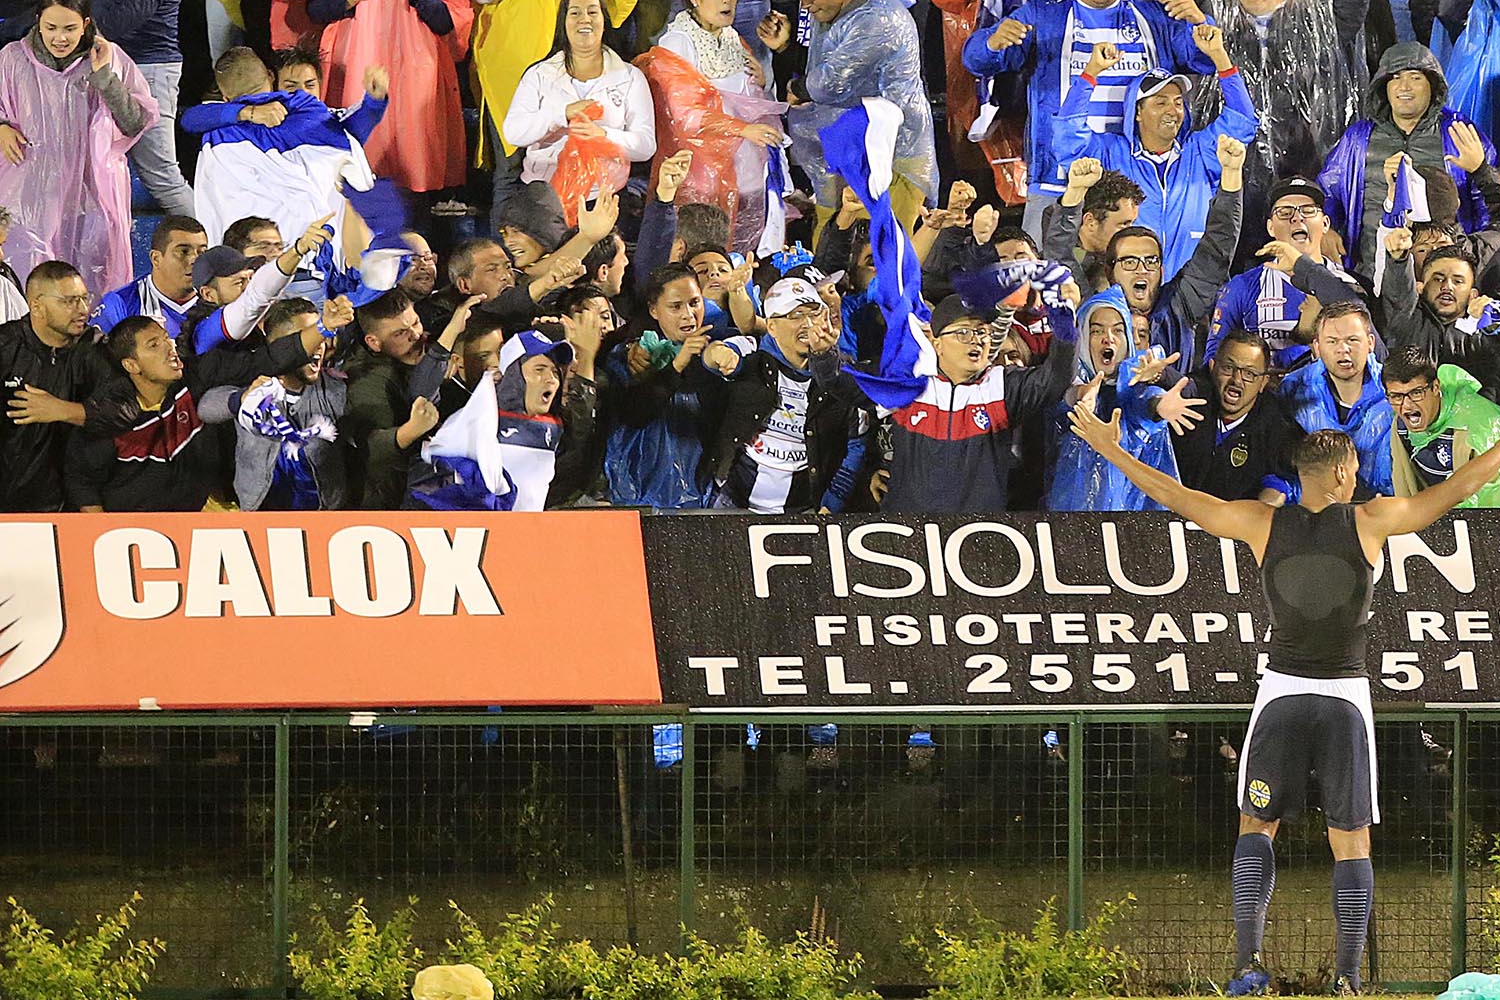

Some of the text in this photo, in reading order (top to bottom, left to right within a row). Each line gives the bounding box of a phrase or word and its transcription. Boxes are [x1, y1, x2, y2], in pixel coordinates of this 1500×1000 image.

[766, 446, 807, 462] HUAW
[93, 525, 503, 619] CALOX
[749, 520, 1476, 598] FISIOLUTN
[814, 611, 1272, 646] FISIOTERAPI
[688, 657, 909, 696] TEL.
[965, 651, 1479, 694] 2551-51
